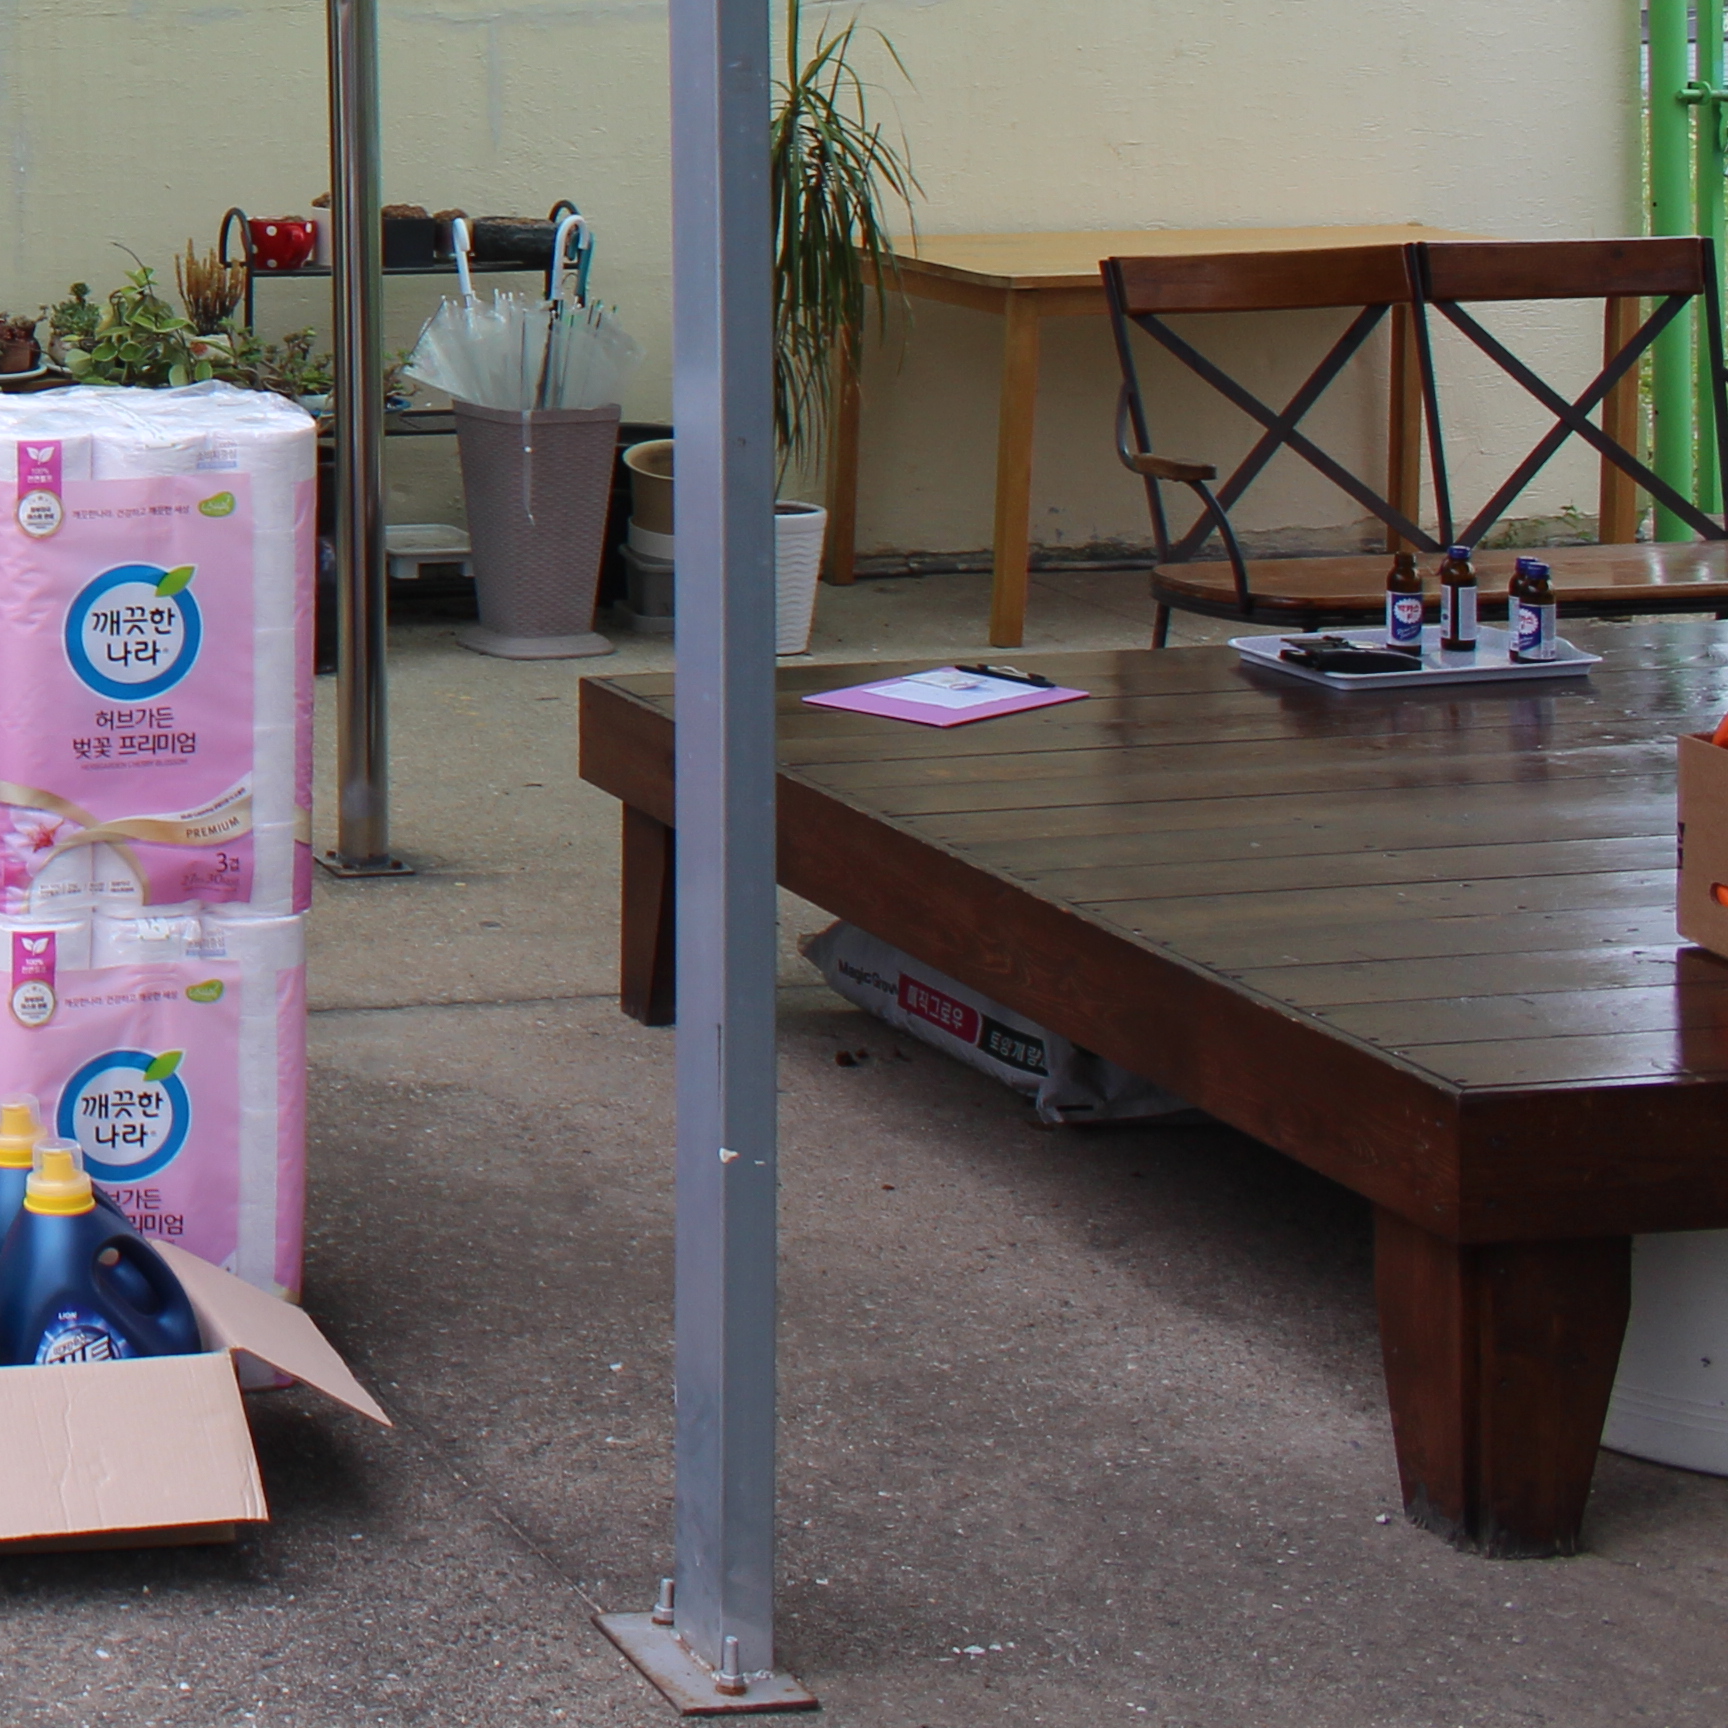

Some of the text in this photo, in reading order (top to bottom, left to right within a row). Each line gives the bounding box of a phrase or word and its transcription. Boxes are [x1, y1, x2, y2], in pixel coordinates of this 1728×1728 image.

[91, 606, 176, 637] 깨끗한
[106, 639, 160, 668] 나라
[96, 706, 174, 731] 허브가든
[72, 731, 197, 760] 벚꽃 프리미엄
[185, 816, 241, 839] PREMIUM
[906, 983, 964, 1030] 매직그로우
[82, 1090, 164, 1119] 깨끗한
[95, 1124, 148, 1149] 나라
[106, 1188, 162, 1211] 브가든
[130, 1214, 184, 1236] 리미엄
[58, 1311, 78, 1321] LION
